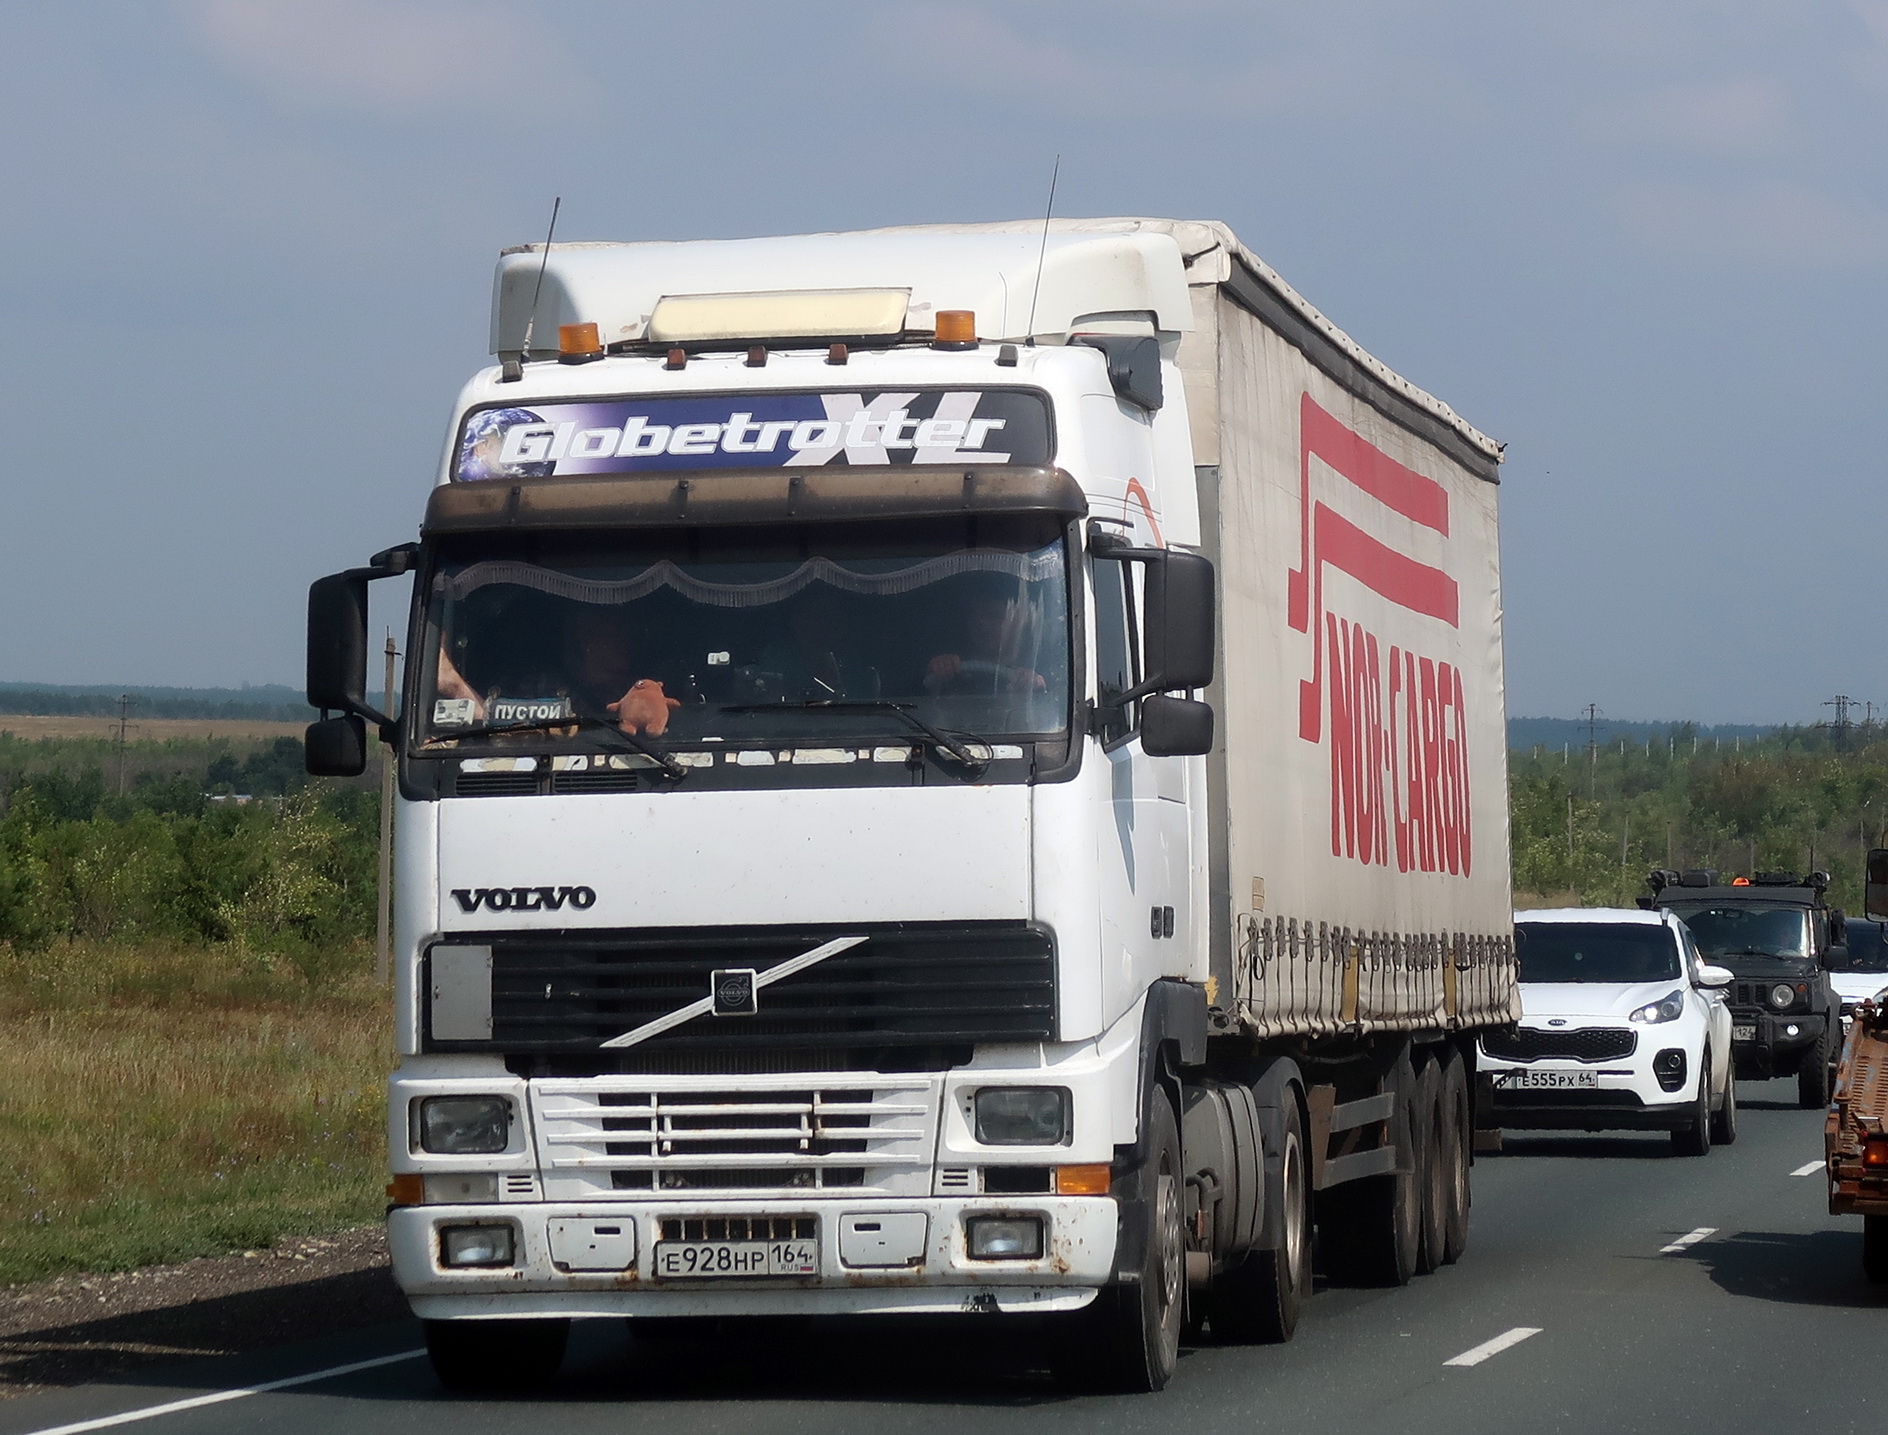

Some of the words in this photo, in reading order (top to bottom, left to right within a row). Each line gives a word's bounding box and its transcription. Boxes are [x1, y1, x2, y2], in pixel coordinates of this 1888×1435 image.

[499, 410, 1007, 463] Globetrotter
[494, 702, 562, 720] ПУСТОЙ
[450, 886, 597, 913] VOLVO
[771, 1244, 810, 1264] 164
